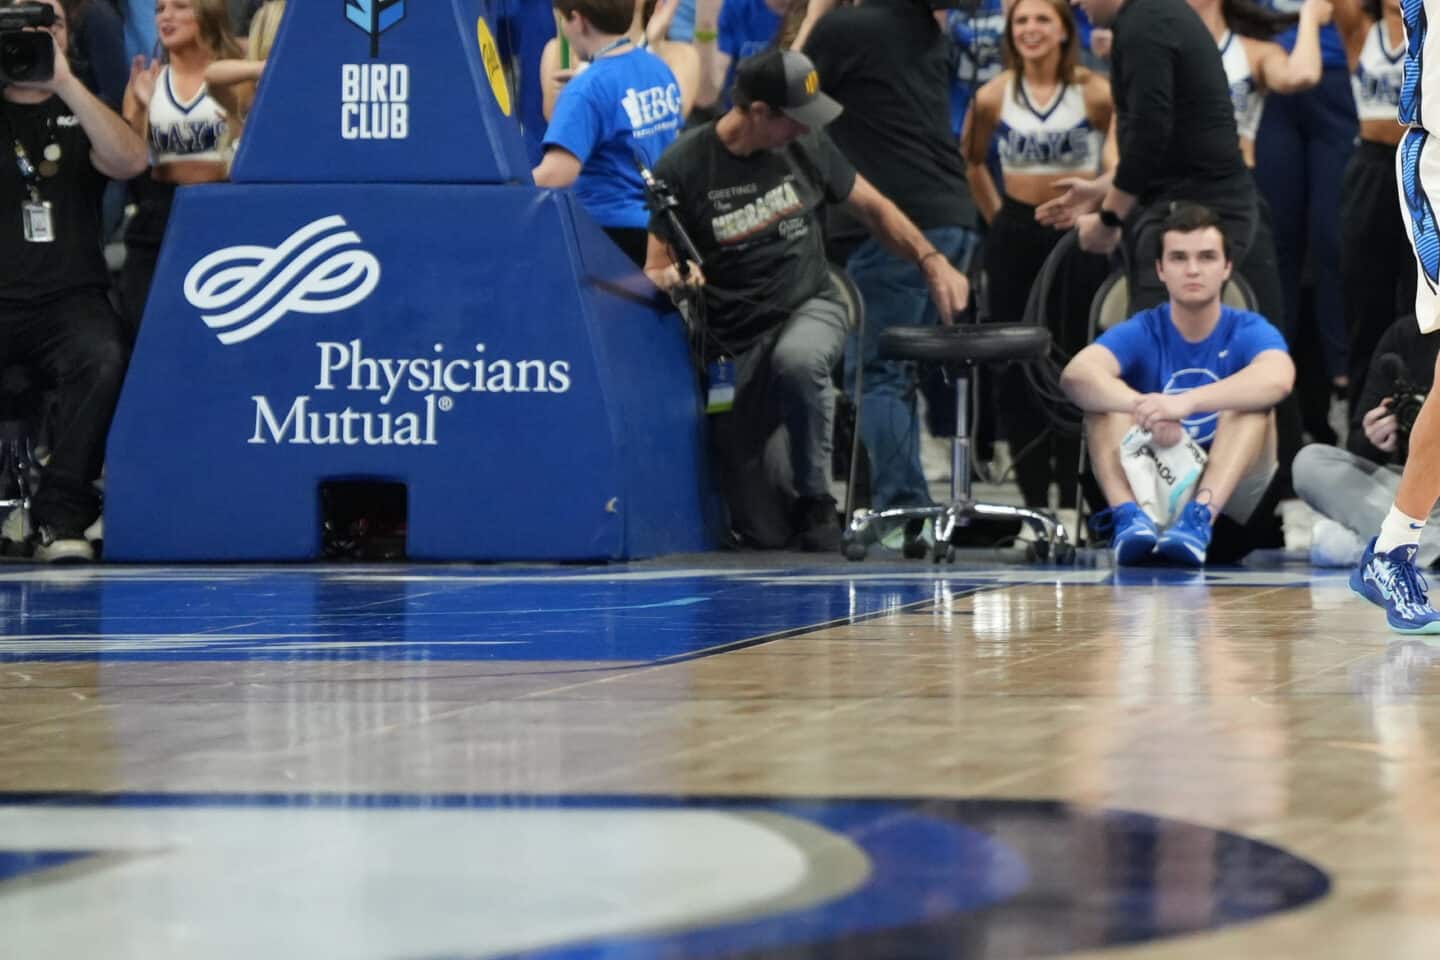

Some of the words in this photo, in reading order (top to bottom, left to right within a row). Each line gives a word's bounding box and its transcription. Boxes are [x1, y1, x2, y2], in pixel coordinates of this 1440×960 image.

[341, 63, 409, 103] BIRD
[341, 102, 408, 140] CLUB
[314, 338, 571, 405] Physicians
